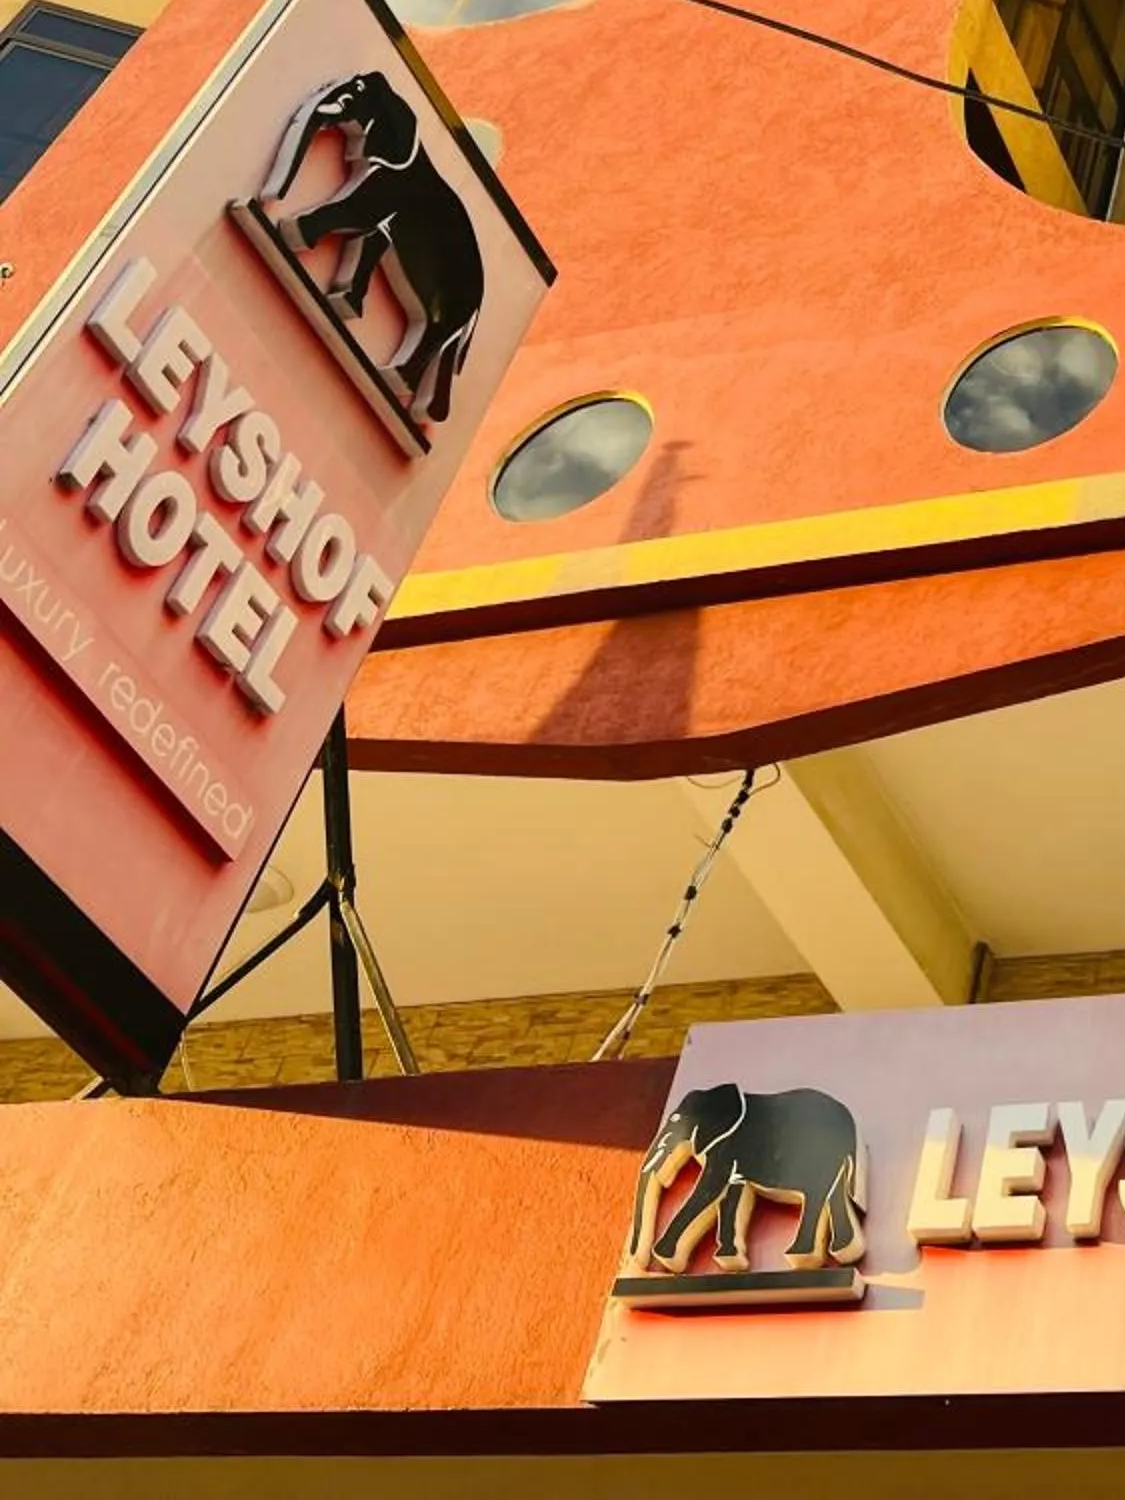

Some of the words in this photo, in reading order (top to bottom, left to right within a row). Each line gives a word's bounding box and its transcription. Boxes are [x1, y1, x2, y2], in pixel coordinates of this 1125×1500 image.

[59, 398, 299, 714] HOTEL
[86, 257, 394, 637] LEYSHOF
[0, 518, 95, 662] uxury
[98, 661, 254, 840] redefined
